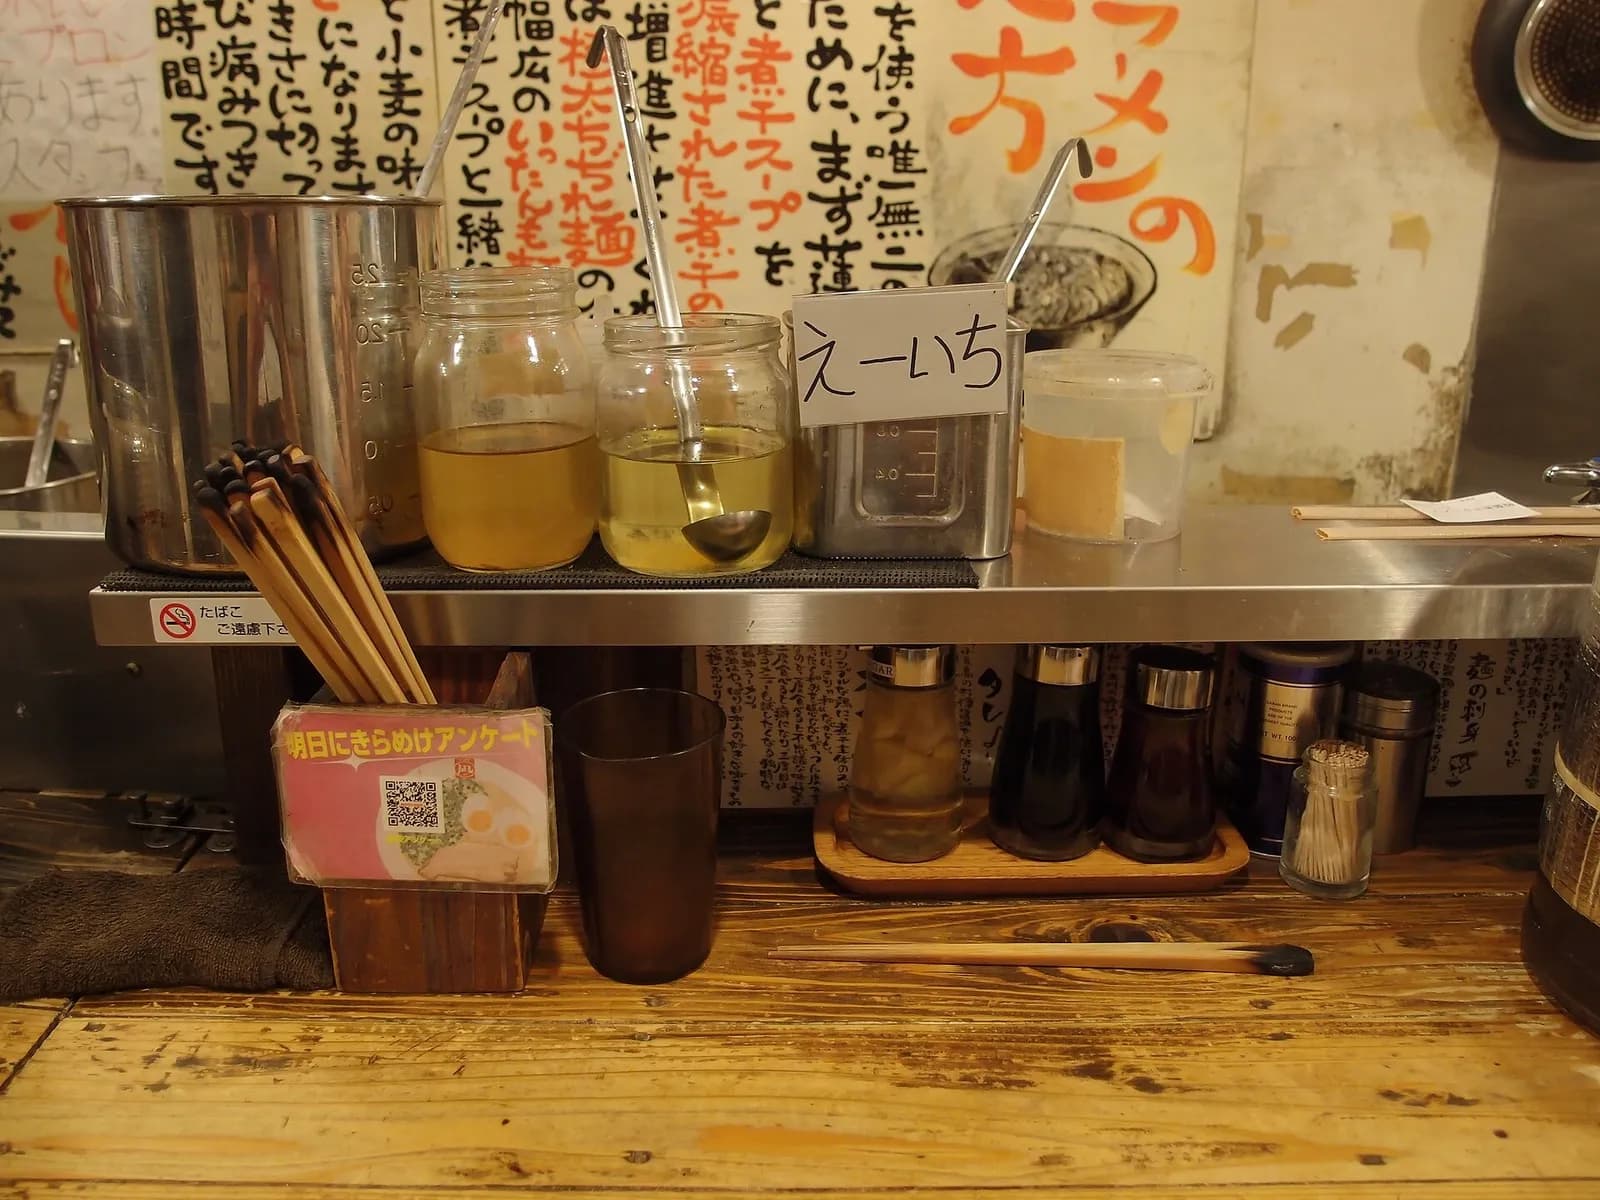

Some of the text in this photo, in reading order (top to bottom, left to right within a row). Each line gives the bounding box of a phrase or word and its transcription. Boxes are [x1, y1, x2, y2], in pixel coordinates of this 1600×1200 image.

[155, 0, 220, 195] 時間です
[443, 0, 505, 268] 煮干スープと一緒
[798, 313, 1003, 402] えーいち
[199, 605, 242, 618] たばこ
[217, 622, 289, 636] ご遠慮下さ
[284, 719, 539, 761] 明日にきらめけアンケート
